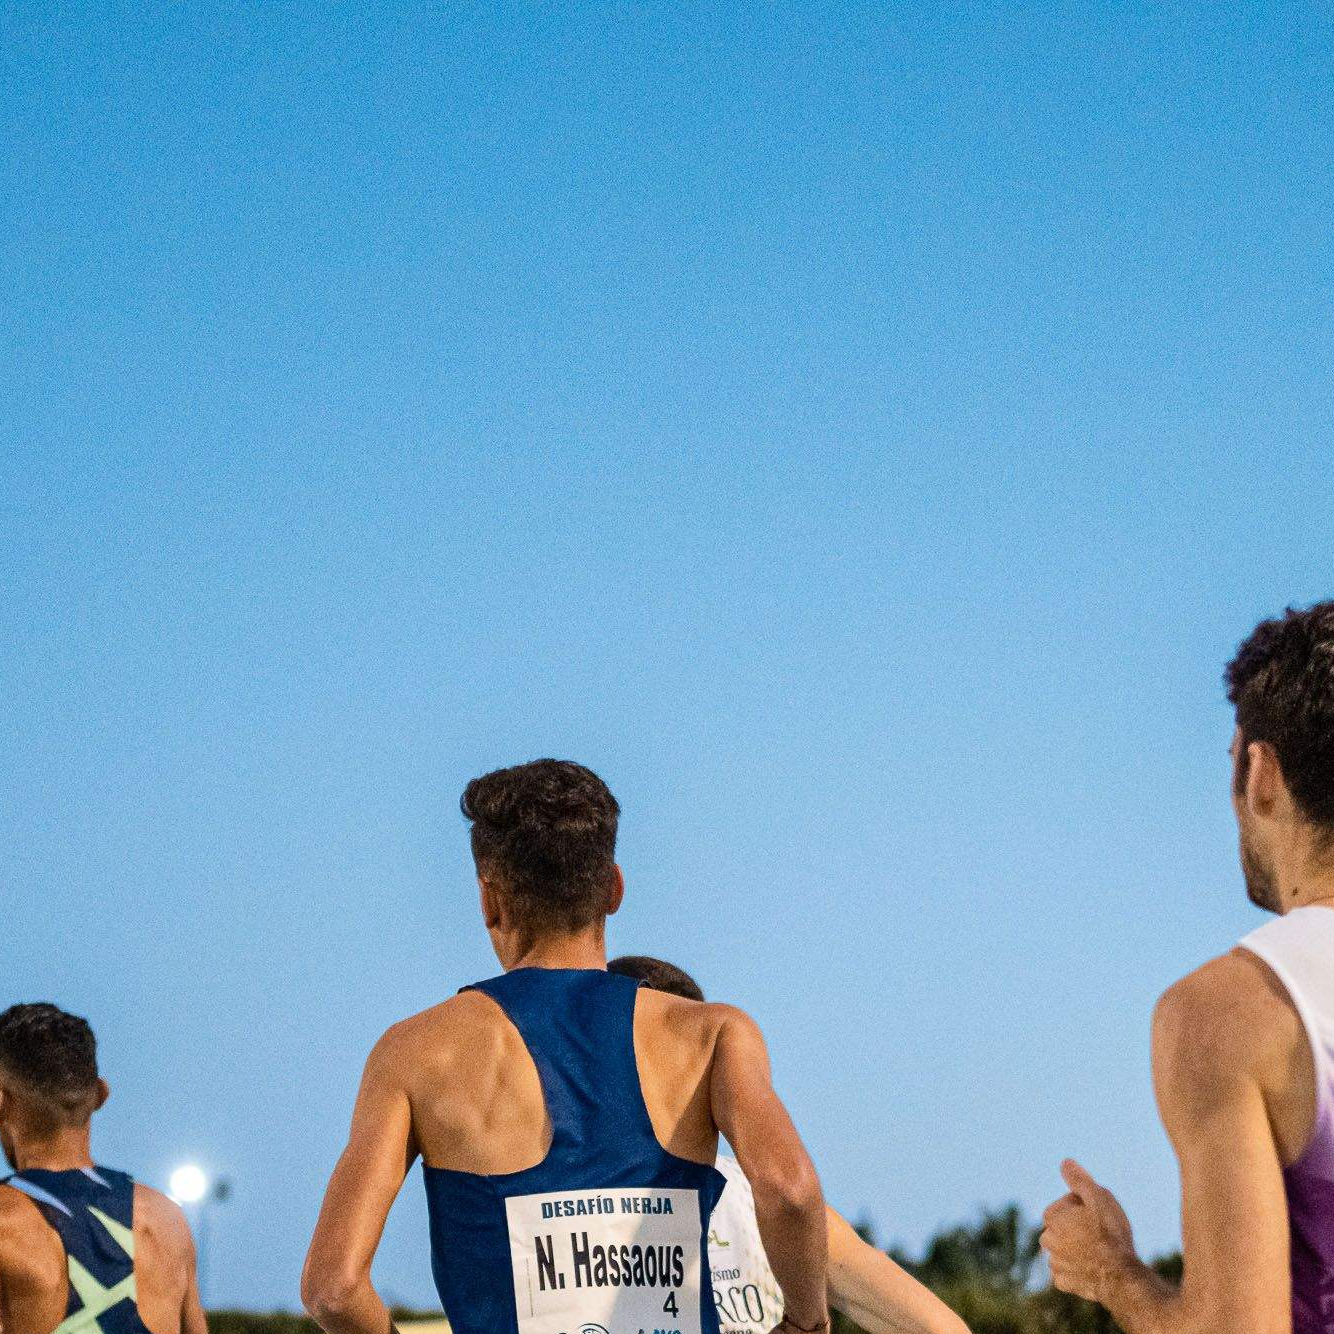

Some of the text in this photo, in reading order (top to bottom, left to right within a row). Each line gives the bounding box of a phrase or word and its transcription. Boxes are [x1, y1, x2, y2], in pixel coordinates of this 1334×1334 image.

[541, 1195, 674, 1219] DESAFÍO NERJA
[534, 1231, 684, 1291] N. Hassaous
[662, 1291, 679, 1318] 4
[712, 1284, 765, 1323] RCO
